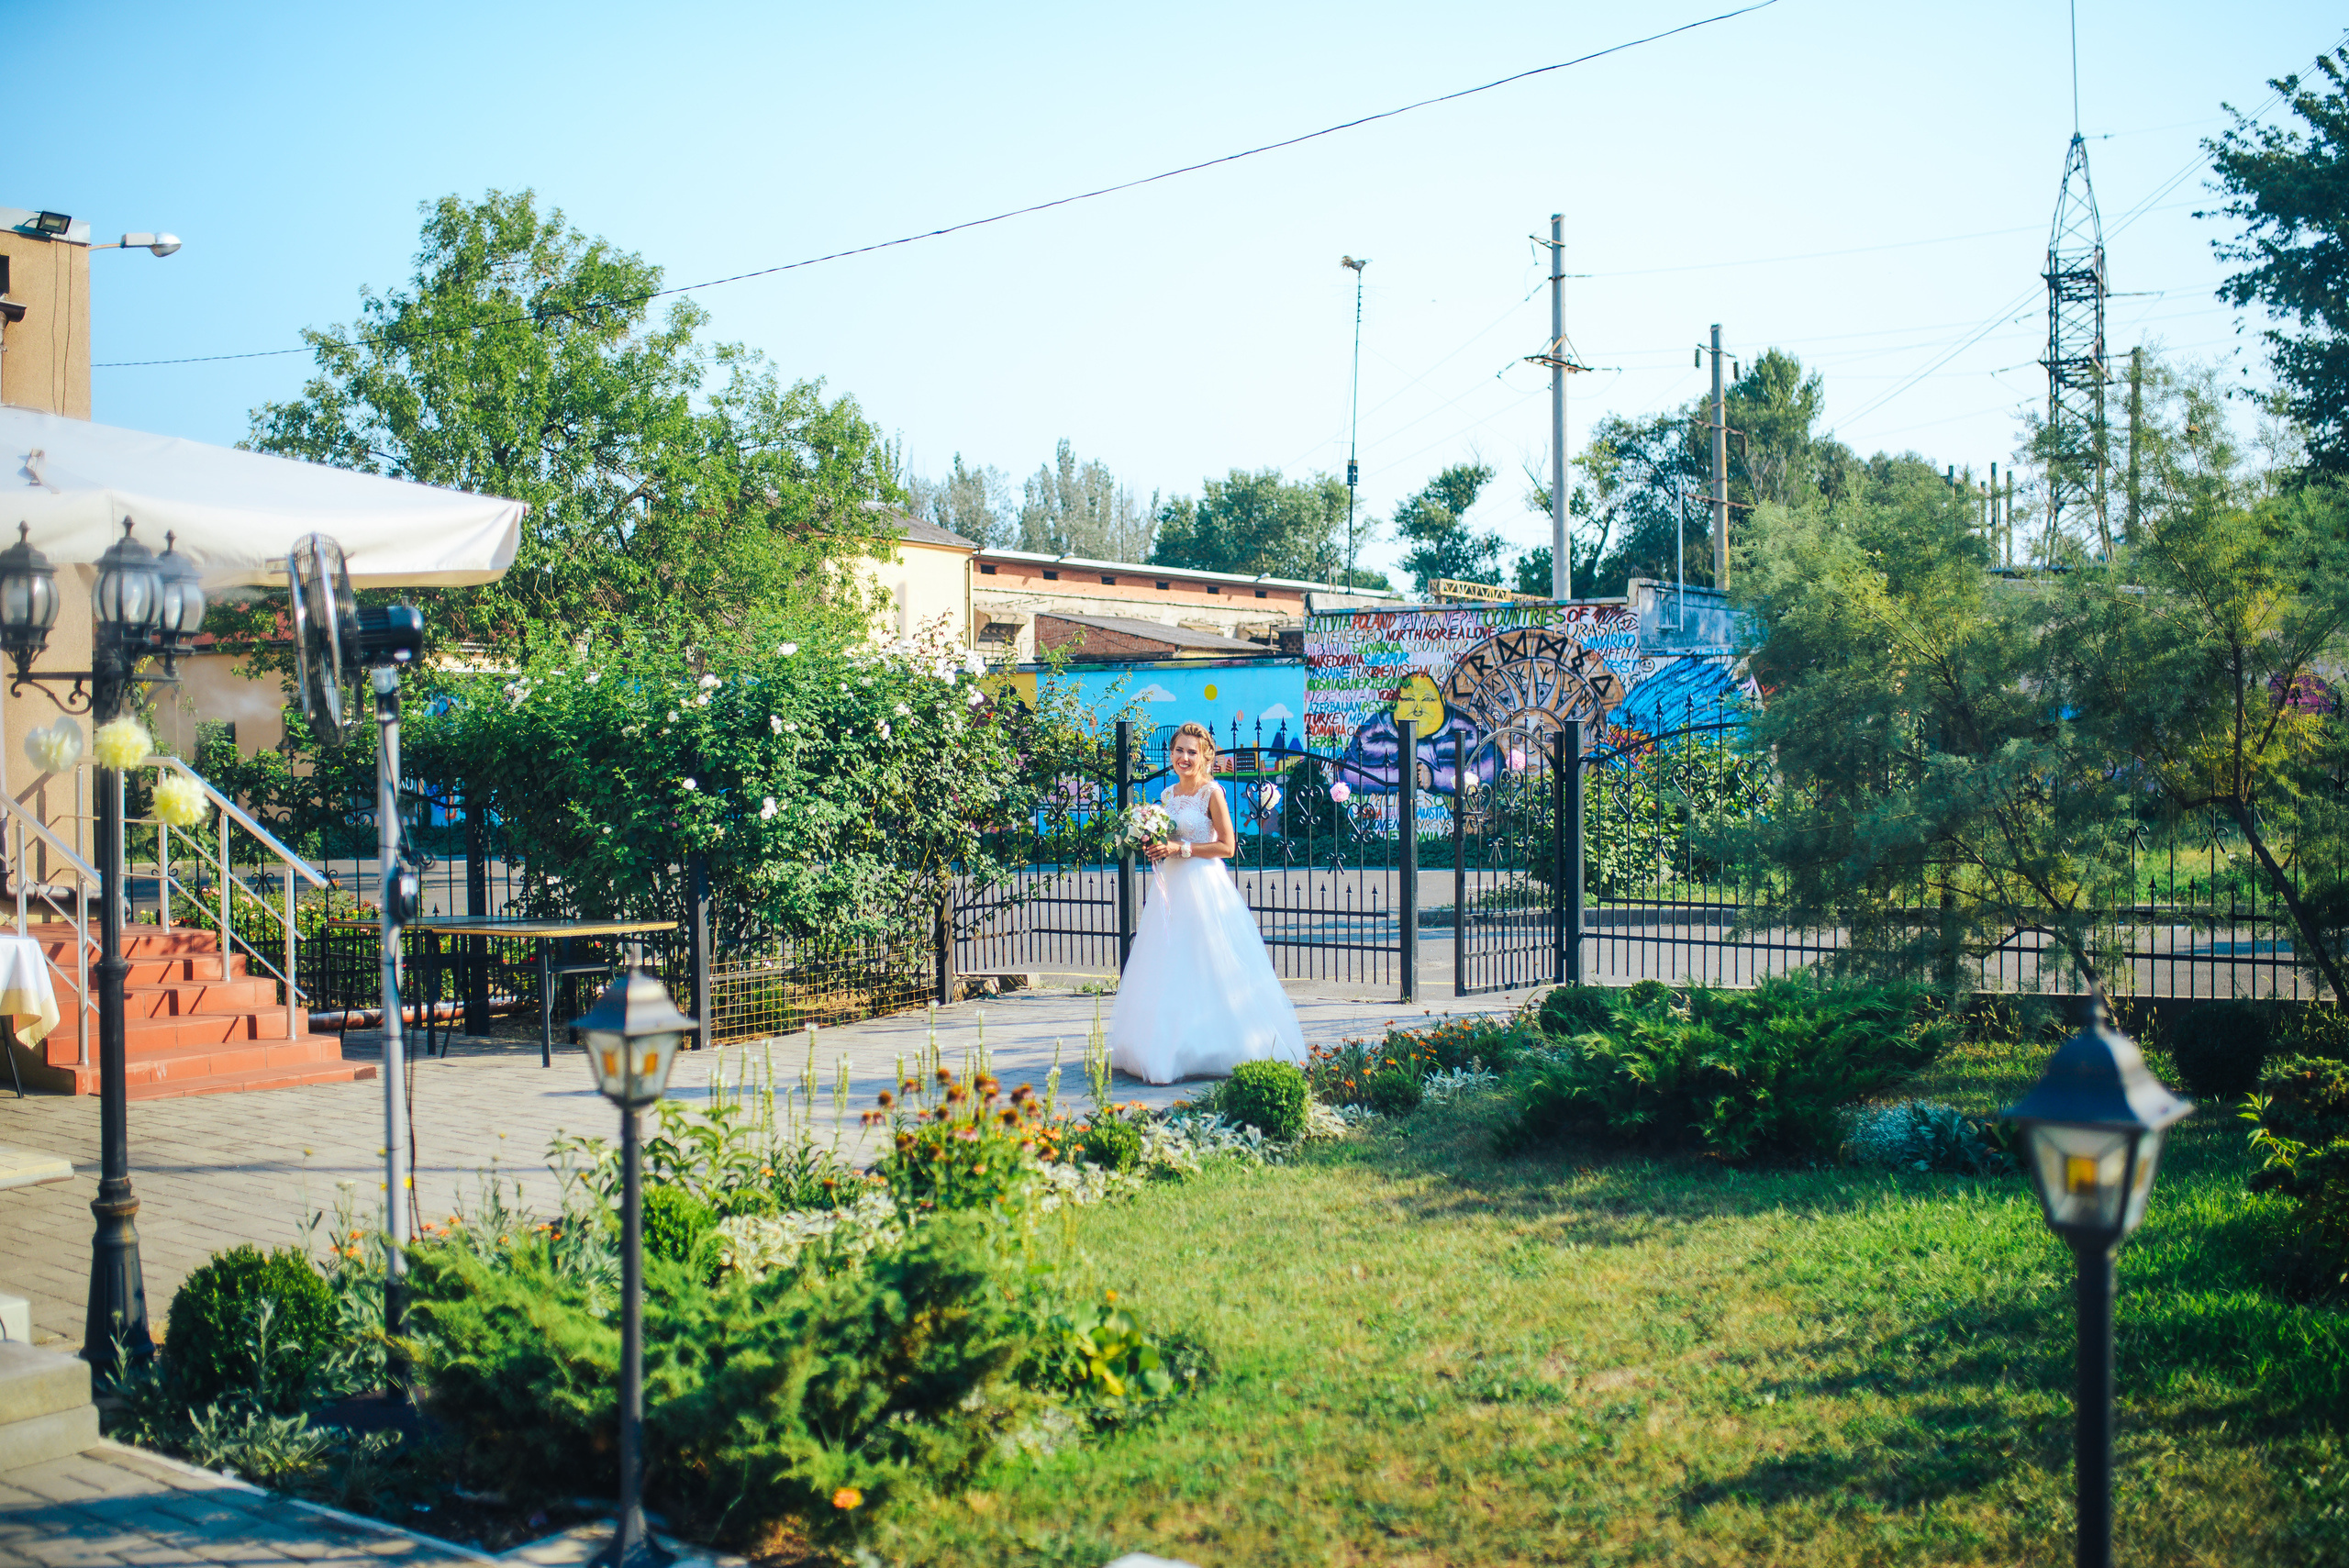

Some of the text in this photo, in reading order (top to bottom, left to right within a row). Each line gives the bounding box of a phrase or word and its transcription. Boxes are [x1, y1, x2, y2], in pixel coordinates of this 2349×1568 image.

[1305, 616, 1353, 633] LATVIA
[1352, 614, 1397, 629] POLAND
[1442, 610, 1485, 628] NEPAL
[1483, 606, 1566, 628] COUNTRIES
[1566, 606, 1589, 623] OF
[1304, 628, 1384, 644] MONTENEGRO
[1385, 628, 1421, 641] NORTH
[1421, 626, 1465, 640] KOREA
[1466, 626, 1497, 639] LOVE
[1553, 624, 1621, 639] EURASIA
[1304, 642, 1352, 656] ALBANIA
[1353, 640, 1404, 654] SLOVAKIA
[1406, 639, 1444, 652] SOUTH
[1308, 666, 1352, 680] UKRAINE
[1352, 663, 1432, 679] TURKMENISTAN
[1304, 689, 1375, 703] UZBEKISTAN
[1308, 700, 1398, 714] AZERBAIJAN PESTO
[1306, 712, 1348, 726] TURKEY
[1308, 736, 1343, 748] SERBA
